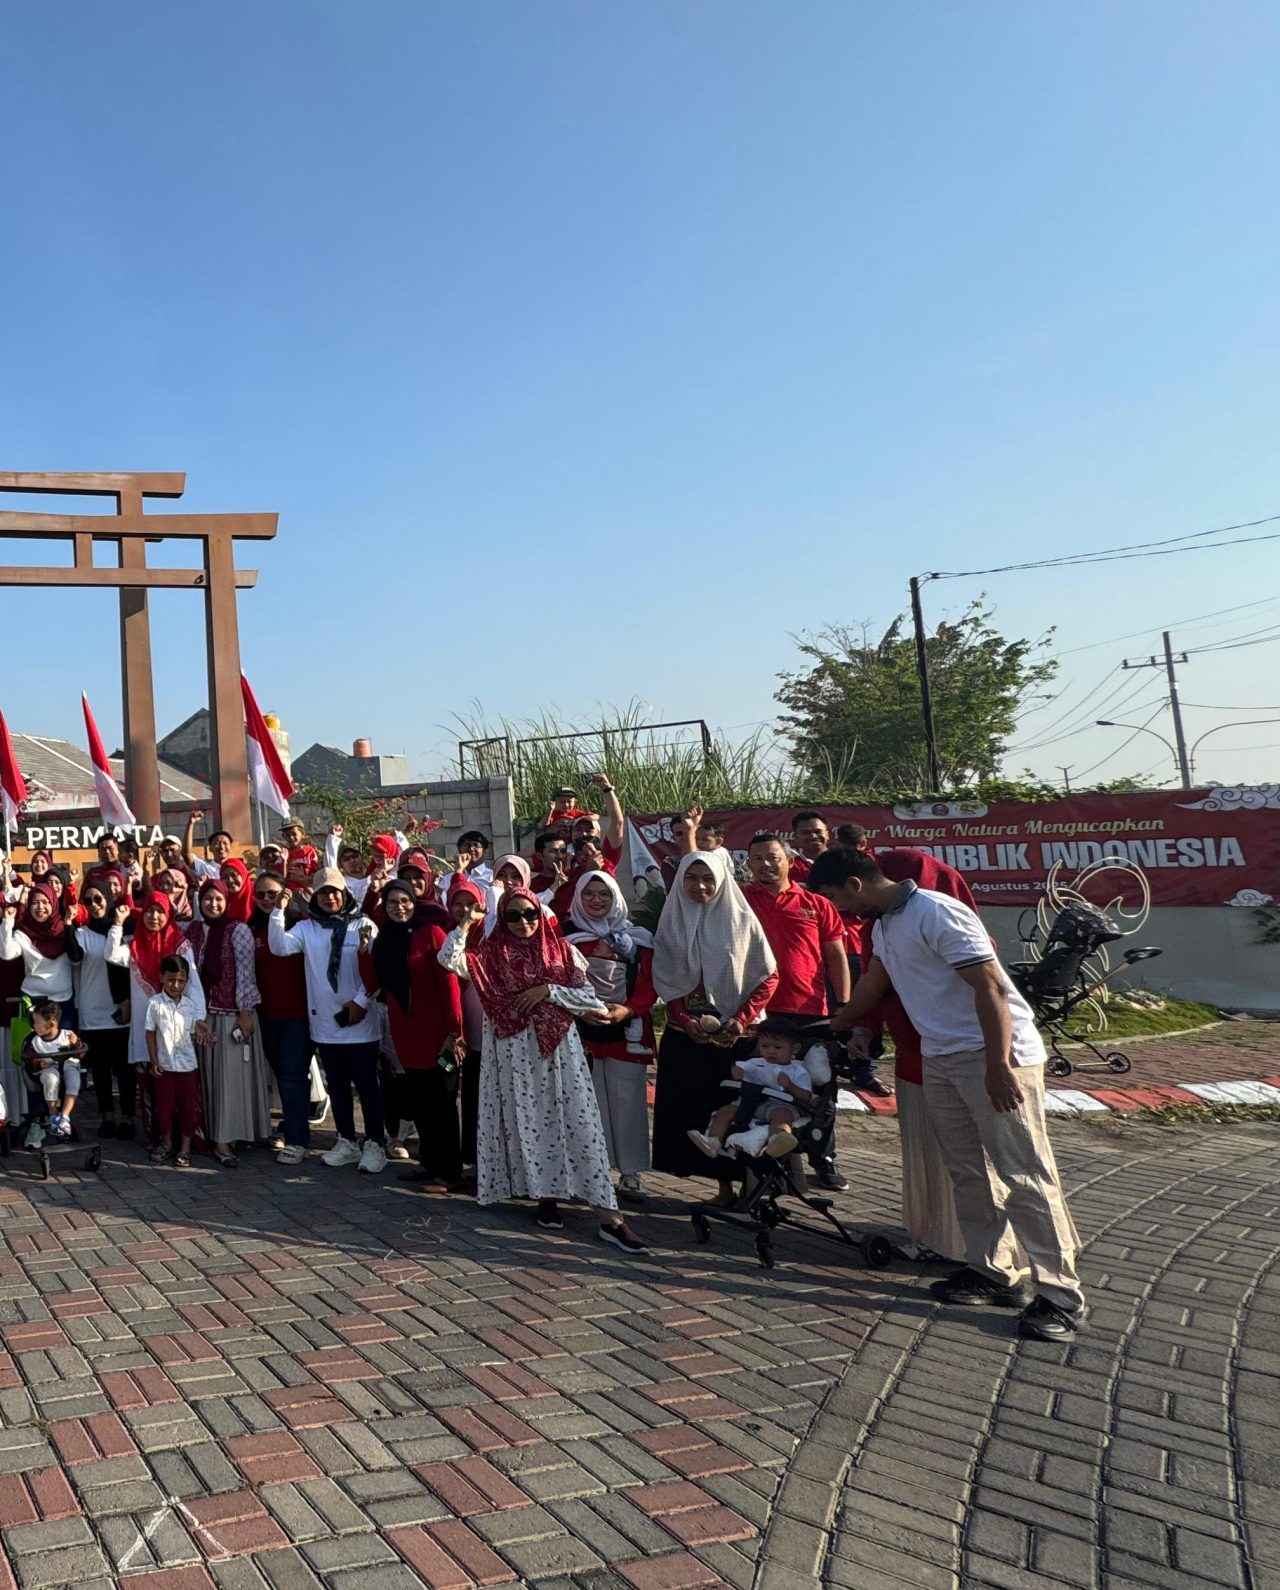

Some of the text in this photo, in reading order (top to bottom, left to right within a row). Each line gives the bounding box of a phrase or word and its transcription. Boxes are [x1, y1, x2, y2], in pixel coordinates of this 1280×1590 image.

[26, 824, 164, 849] PERMATA
[884, 824, 947, 841] Warga
[952, 823, 1019, 837] Natura
[1024, 818, 1165, 838] Mengucapkan
[1041, 837, 1246, 870] INDONESIA
[971, 881, 1030, 892] Agustus
